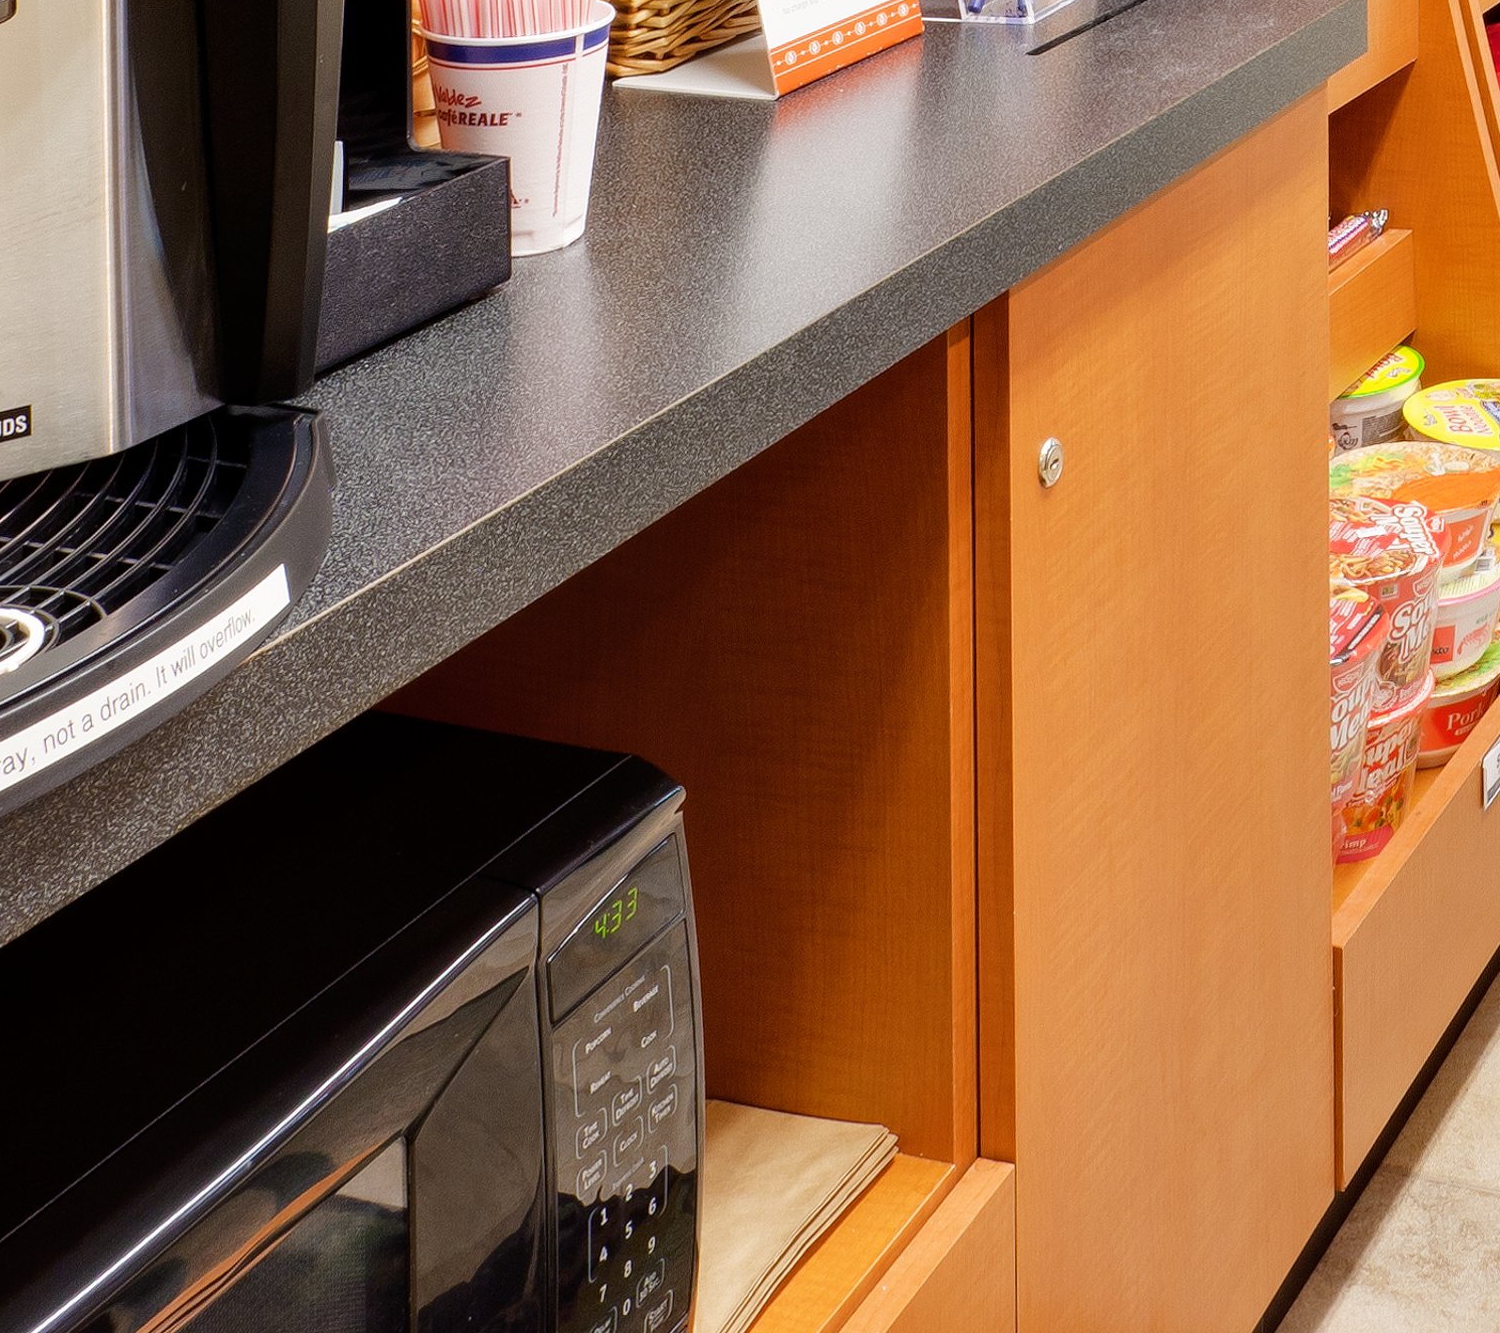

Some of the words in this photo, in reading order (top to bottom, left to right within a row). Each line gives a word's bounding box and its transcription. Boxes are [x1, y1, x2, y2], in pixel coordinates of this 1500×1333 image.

[42, 720, 76, 756] not
[82, 711, 94, 731] a
[100, 681, 151, 723] drain.
[155, 665, 168, 689] It
[170, 646, 196, 679] will
[199, 607, 256, 661] overflow.
[595, 887, 637, 939] 4:33
[600, 1208, 608, 1226] 1
[625, 1184, 633, 1201] 2
[649, 1161, 657, 1179] 3
[600, 1246, 608, 1263] 4
[625, 1221, 632, 1239] 5
[648, 1197, 656, 1215] 6
[599, 1284, 607, 1303] 7
[624, 1260, 632, 1278] 8
[648, 1237, 656, 1254] 9
[623, 1298, 631, 1316] 0
